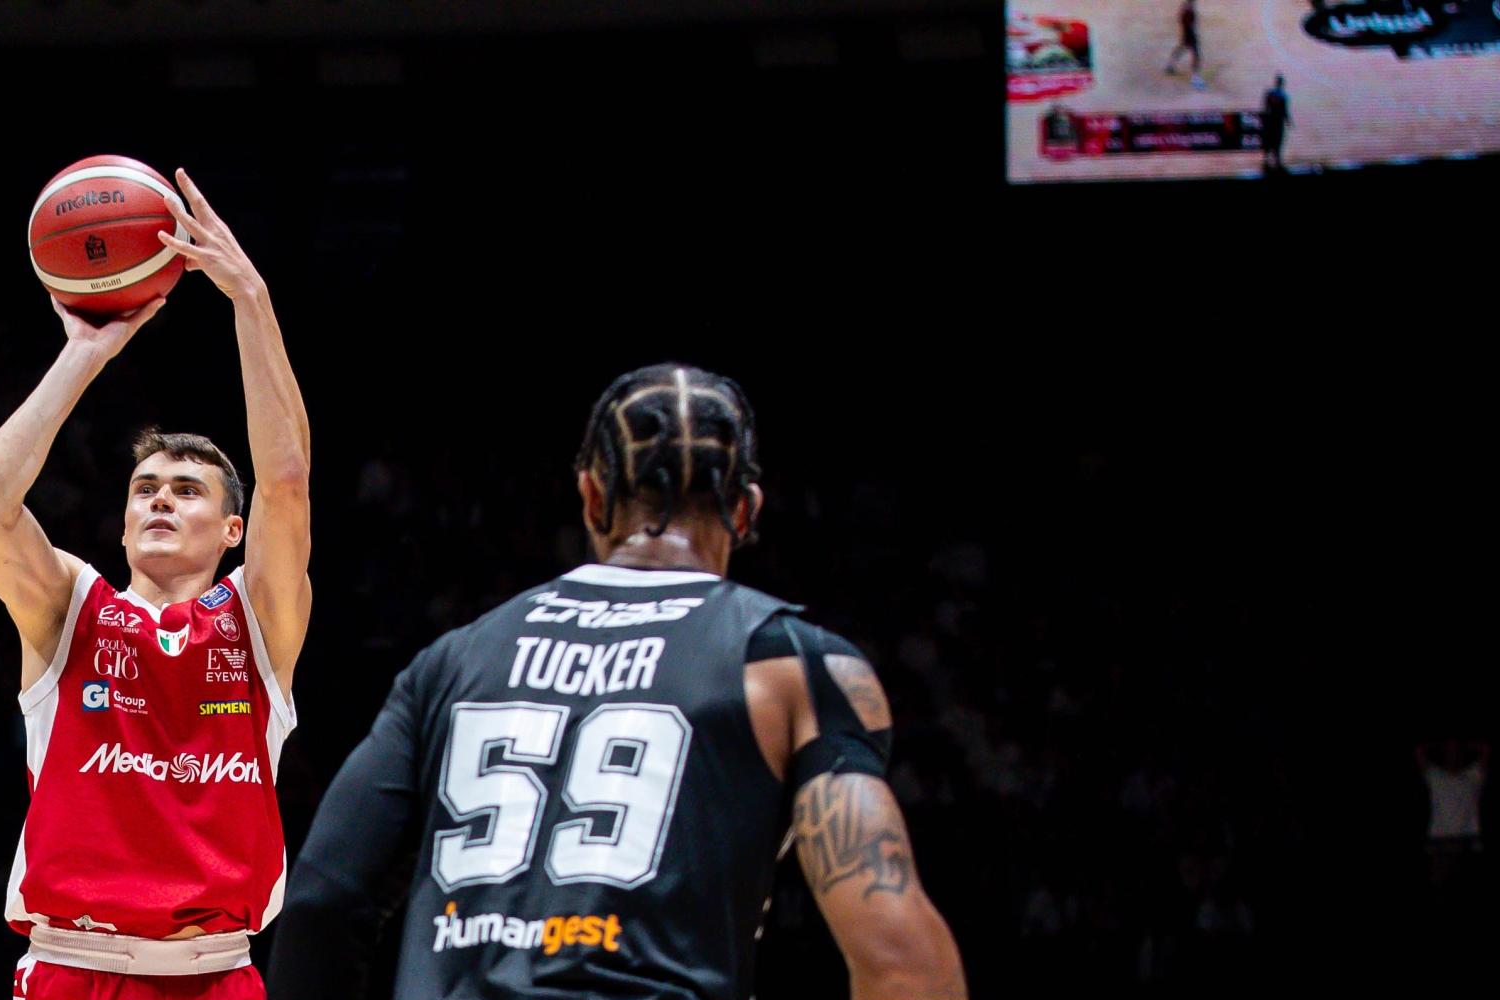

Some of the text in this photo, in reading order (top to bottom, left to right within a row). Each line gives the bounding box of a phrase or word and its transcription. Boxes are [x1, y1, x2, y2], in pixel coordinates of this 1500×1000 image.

[56, 190, 125, 216] molten
[98, 604, 143, 627] EA7
[508, 636, 665, 696] TUCKER
[113, 690, 146, 709] Group
[79, 742, 169, 781] Media
[431, 701, 693, 894] 59
